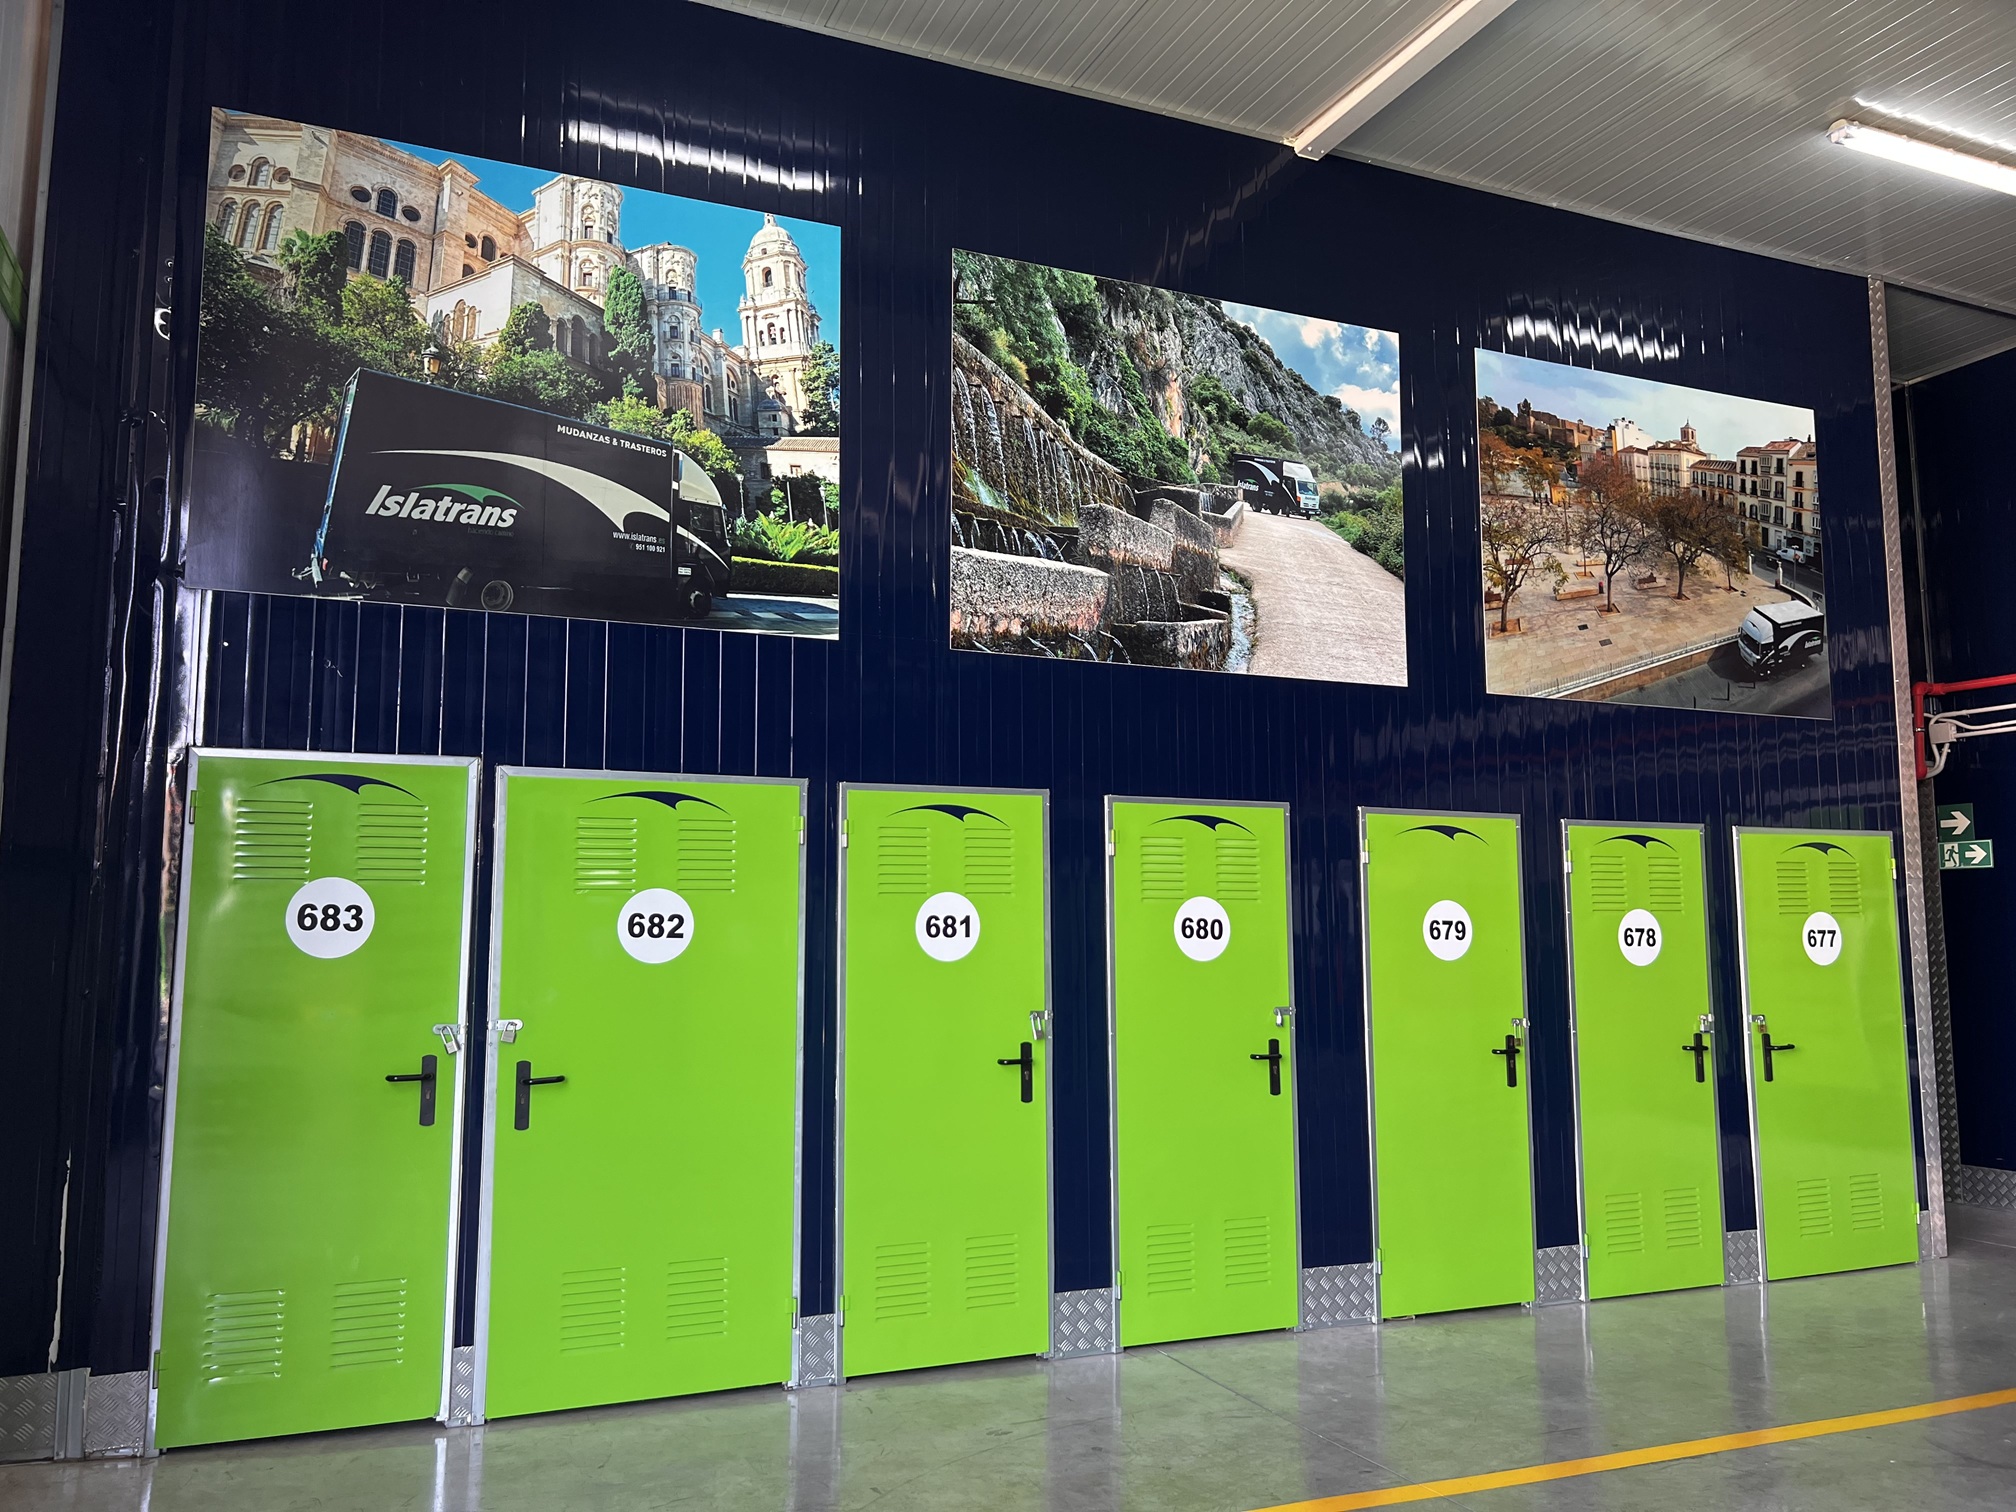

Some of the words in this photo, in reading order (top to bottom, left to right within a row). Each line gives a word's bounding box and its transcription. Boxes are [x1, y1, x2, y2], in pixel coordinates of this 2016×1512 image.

[557, 424, 611, 445] MUDANZAS
[612, 438, 618, 446] &
[620, 439, 667, 457] TRASTEROS
[365, 485, 517, 527] Islatrans
[635, 543, 645, 551] 951
[297, 903, 363, 932] 683
[628, 912, 685, 939] 682
[926, 915, 971, 938] 681
[1181, 917, 1224, 941] 680
[1429, 919, 1466, 941] 679
[1624, 927, 1657, 947] 678
[1808, 929, 1837, 948] 677
